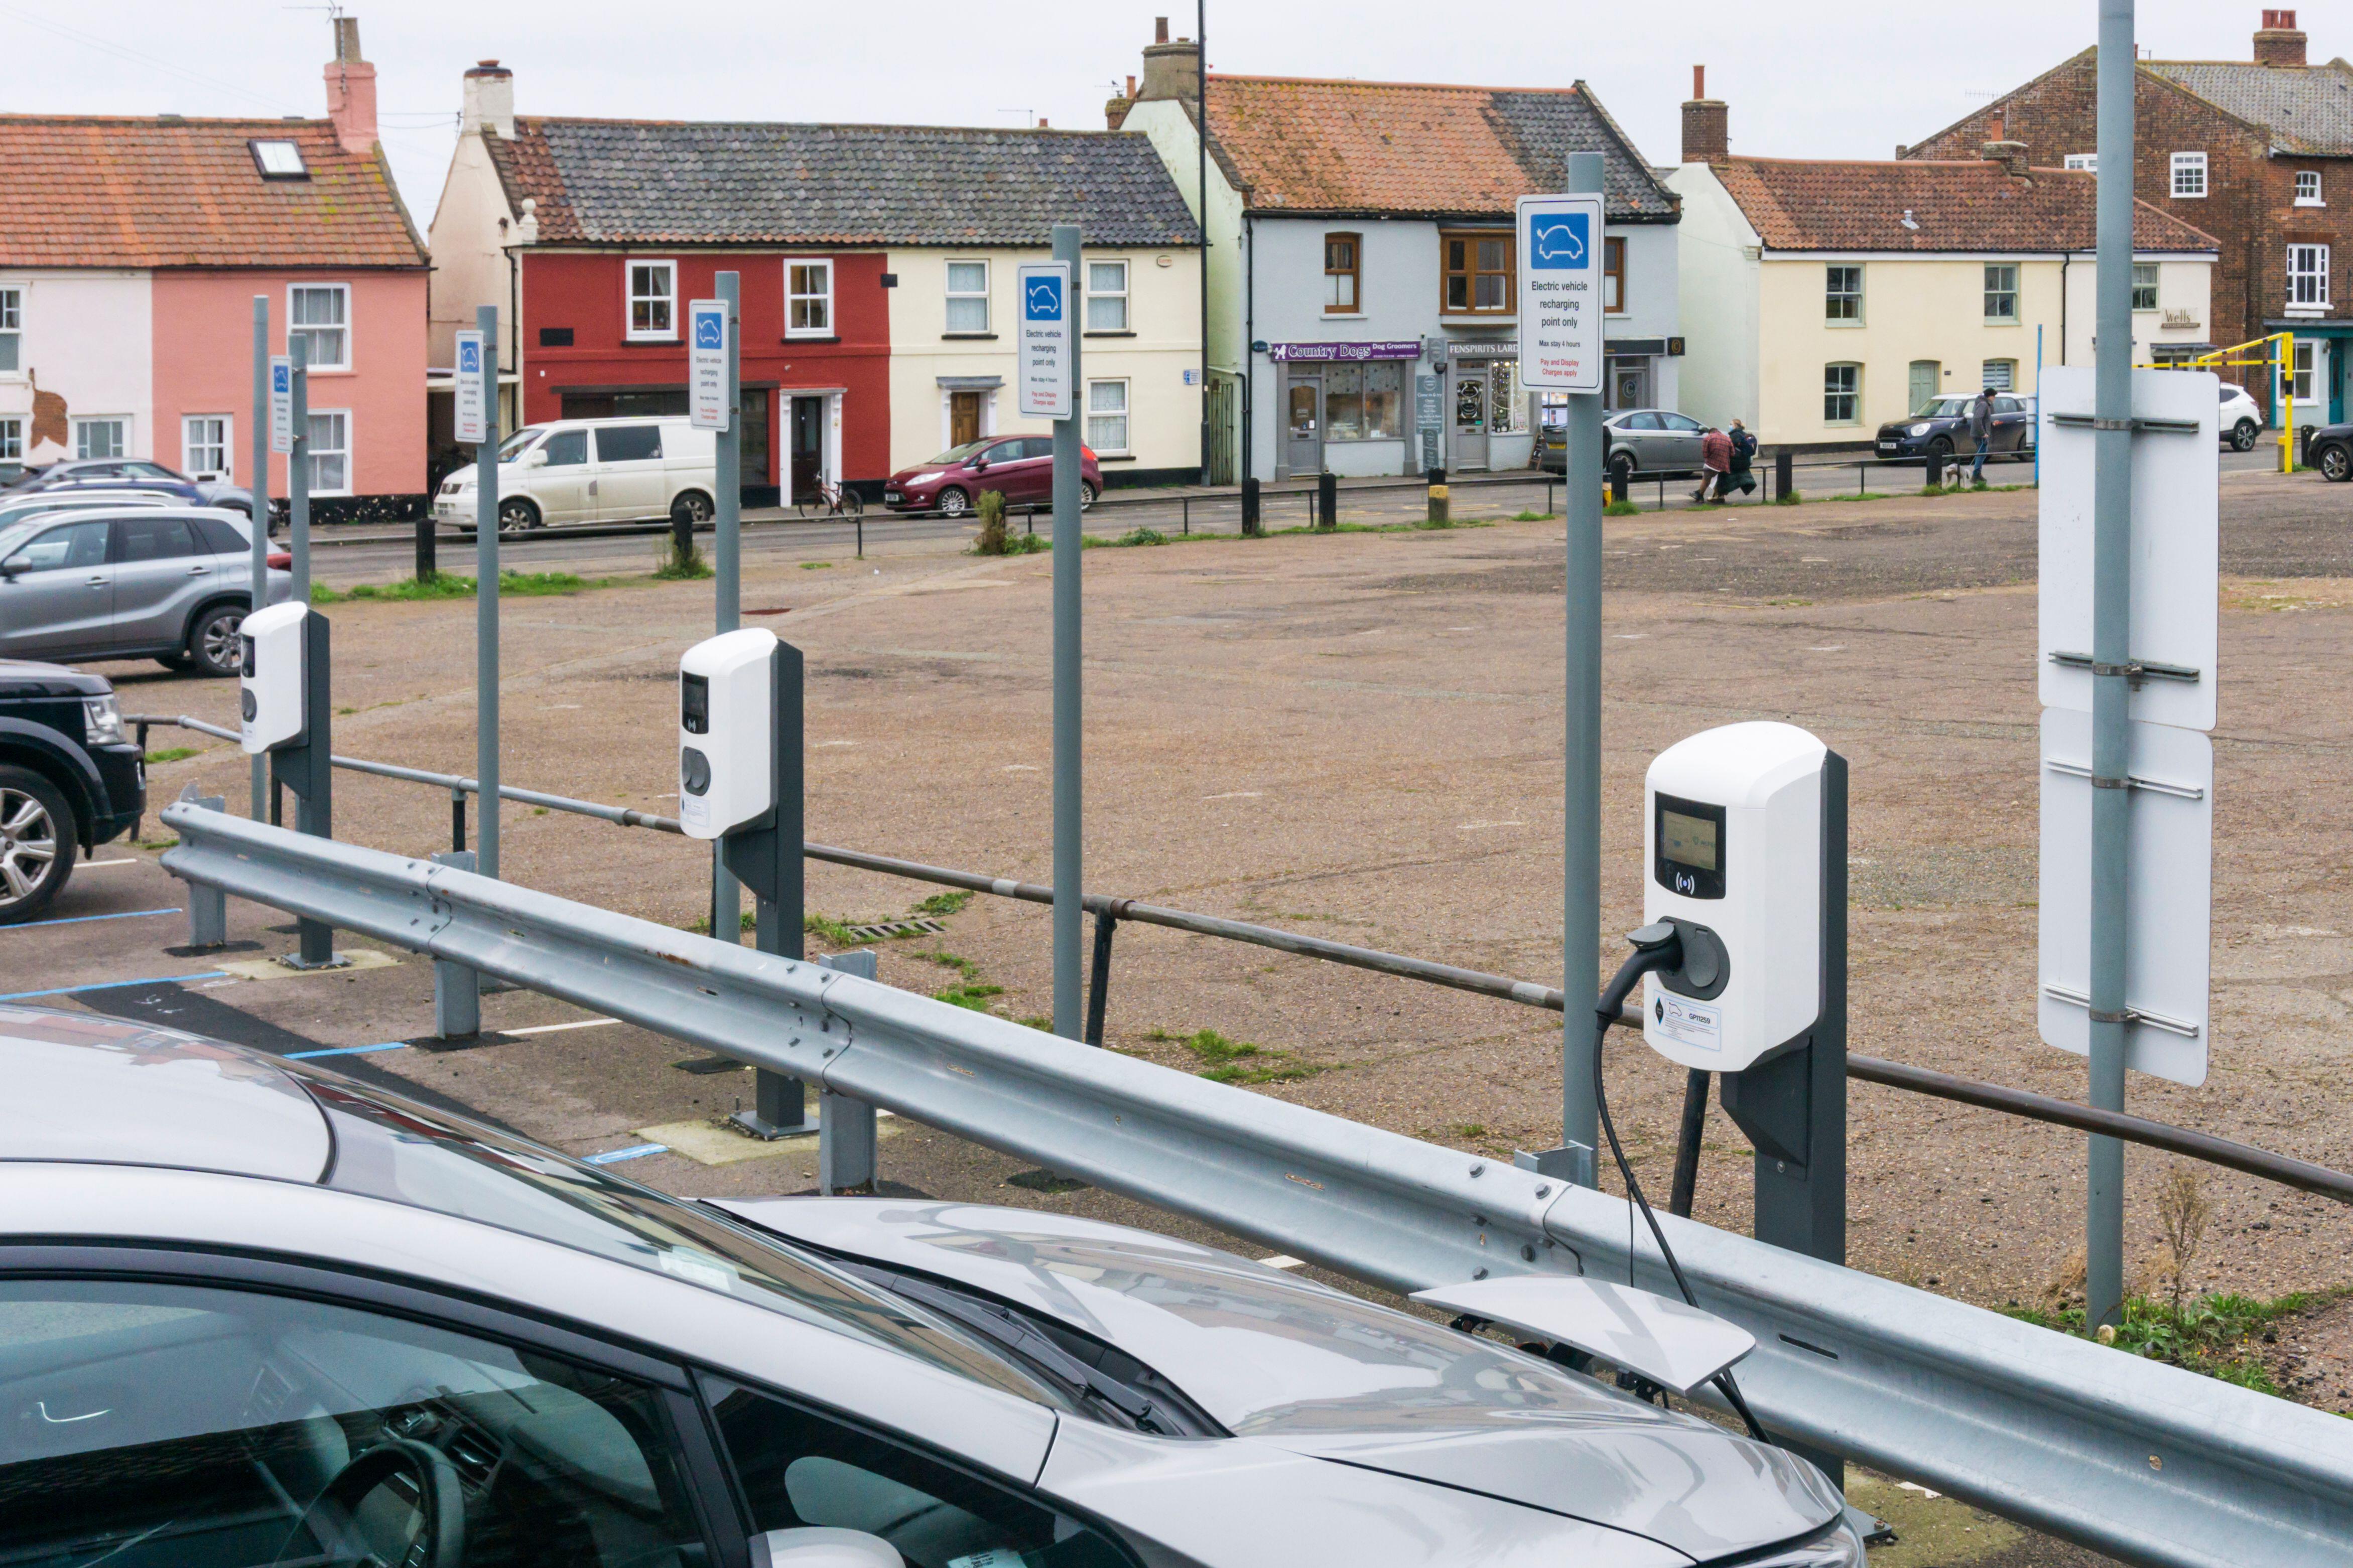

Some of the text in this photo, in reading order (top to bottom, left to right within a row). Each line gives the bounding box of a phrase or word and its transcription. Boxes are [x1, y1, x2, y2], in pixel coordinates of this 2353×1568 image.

[1532, 281, 1588, 291] Electric vehicle
[1540, 299, 1579, 311] recharging
[2165, 309, 2190, 322] Wells
[1542, 317, 1578, 328] point only
[1044, 330, 1062, 338] vehicle
[1031, 344, 1056, 354] recharging
[1288, 344, 1370, 359] Country Dogs
[1450, 345, 1495, 353] FENSPIRITS
[1032, 358, 1056, 367] point only
[1561, 359, 1579, 367] Display
[1689, 1013, 1711, 1024] GP11259
